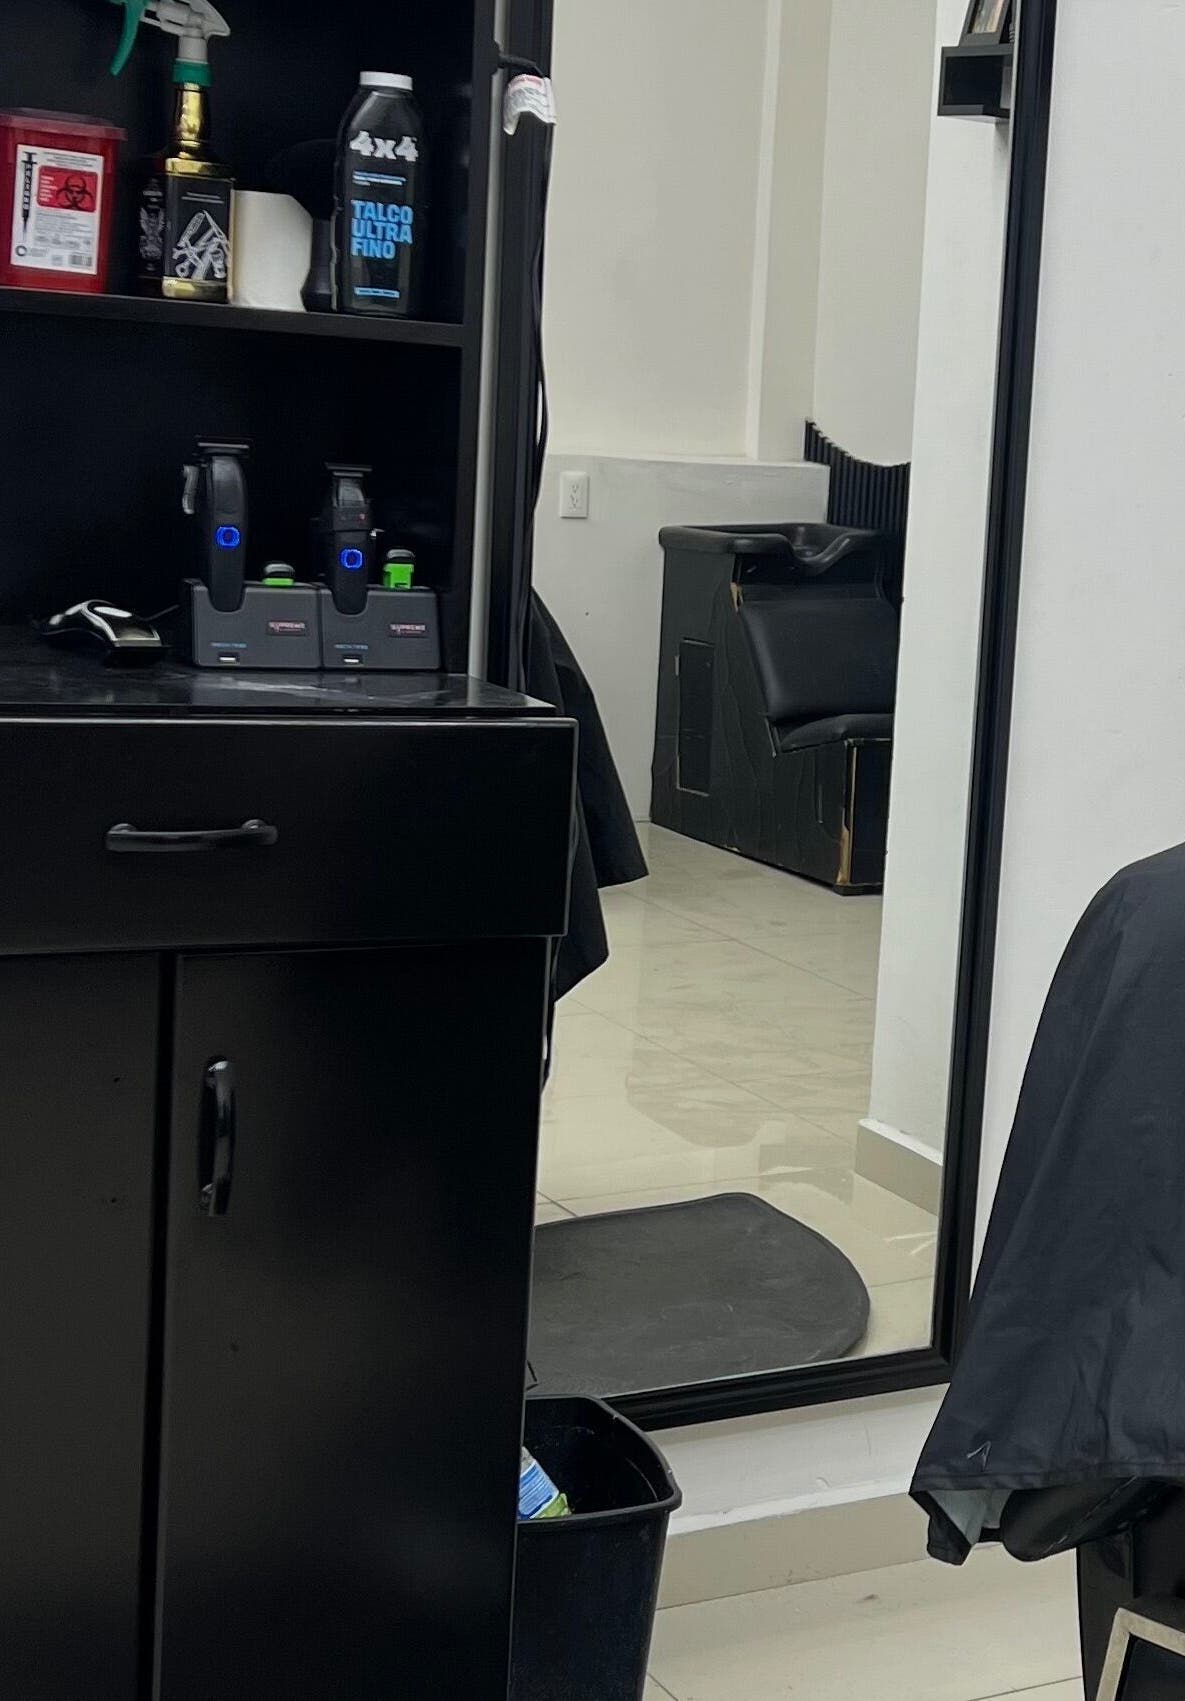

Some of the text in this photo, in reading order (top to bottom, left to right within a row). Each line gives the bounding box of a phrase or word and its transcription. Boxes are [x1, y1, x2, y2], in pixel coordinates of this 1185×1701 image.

[350, 130, 419, 161] 4x4
[351, 199, 413, 225] TALCO
[351, 218, 413, 244] ULTRA
[351, 236, 396, 260] FINO
